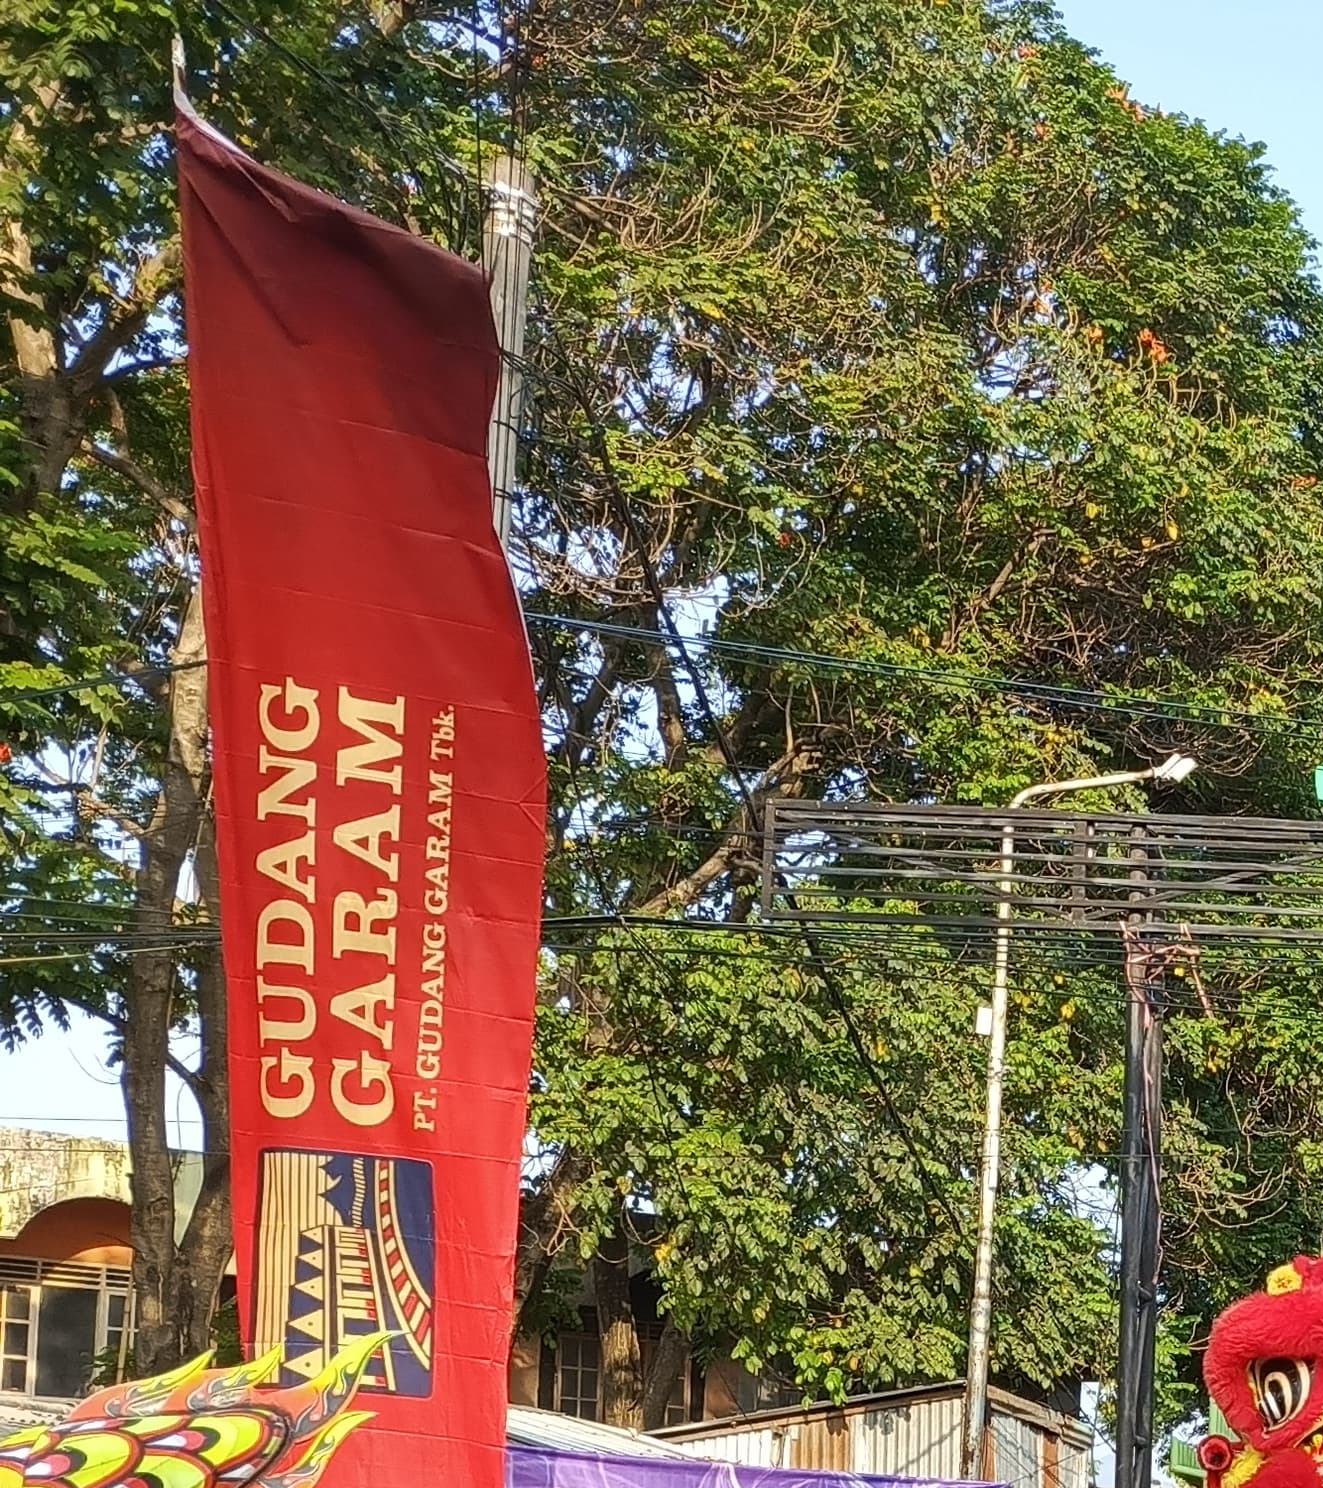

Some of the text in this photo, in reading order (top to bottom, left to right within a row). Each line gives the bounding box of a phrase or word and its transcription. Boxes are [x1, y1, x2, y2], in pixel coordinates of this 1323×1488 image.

[257, 675, 320, 1119] GUDANG
[330, 685, 407, 1127] GARAM
[412, 704, 456, 1134] PT. GUDANG GARAM Tbk.
